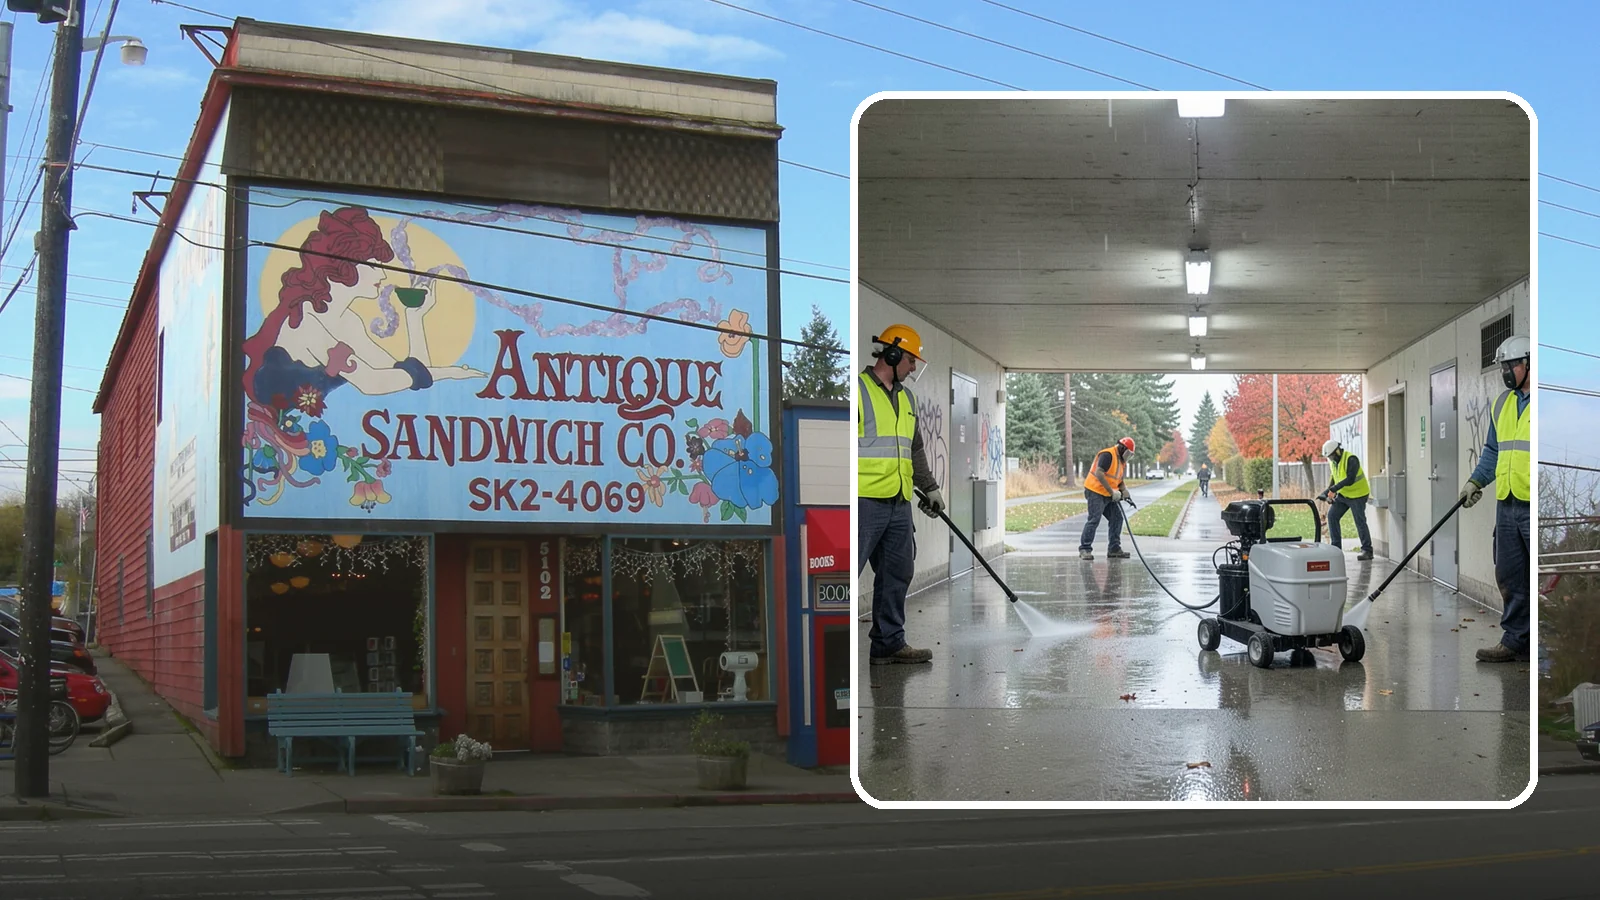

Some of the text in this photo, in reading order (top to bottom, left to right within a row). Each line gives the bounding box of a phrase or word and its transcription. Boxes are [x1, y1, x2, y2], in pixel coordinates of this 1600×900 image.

[477, 330, 723, 420] ANTIQUE
[361, 409, 684, 468] SANDWICH CO.
[468, 477, 645, 512] SK2-4069
[540, 542, 552, 599] 5102
[809, 555, 835, 569] BOOKS
